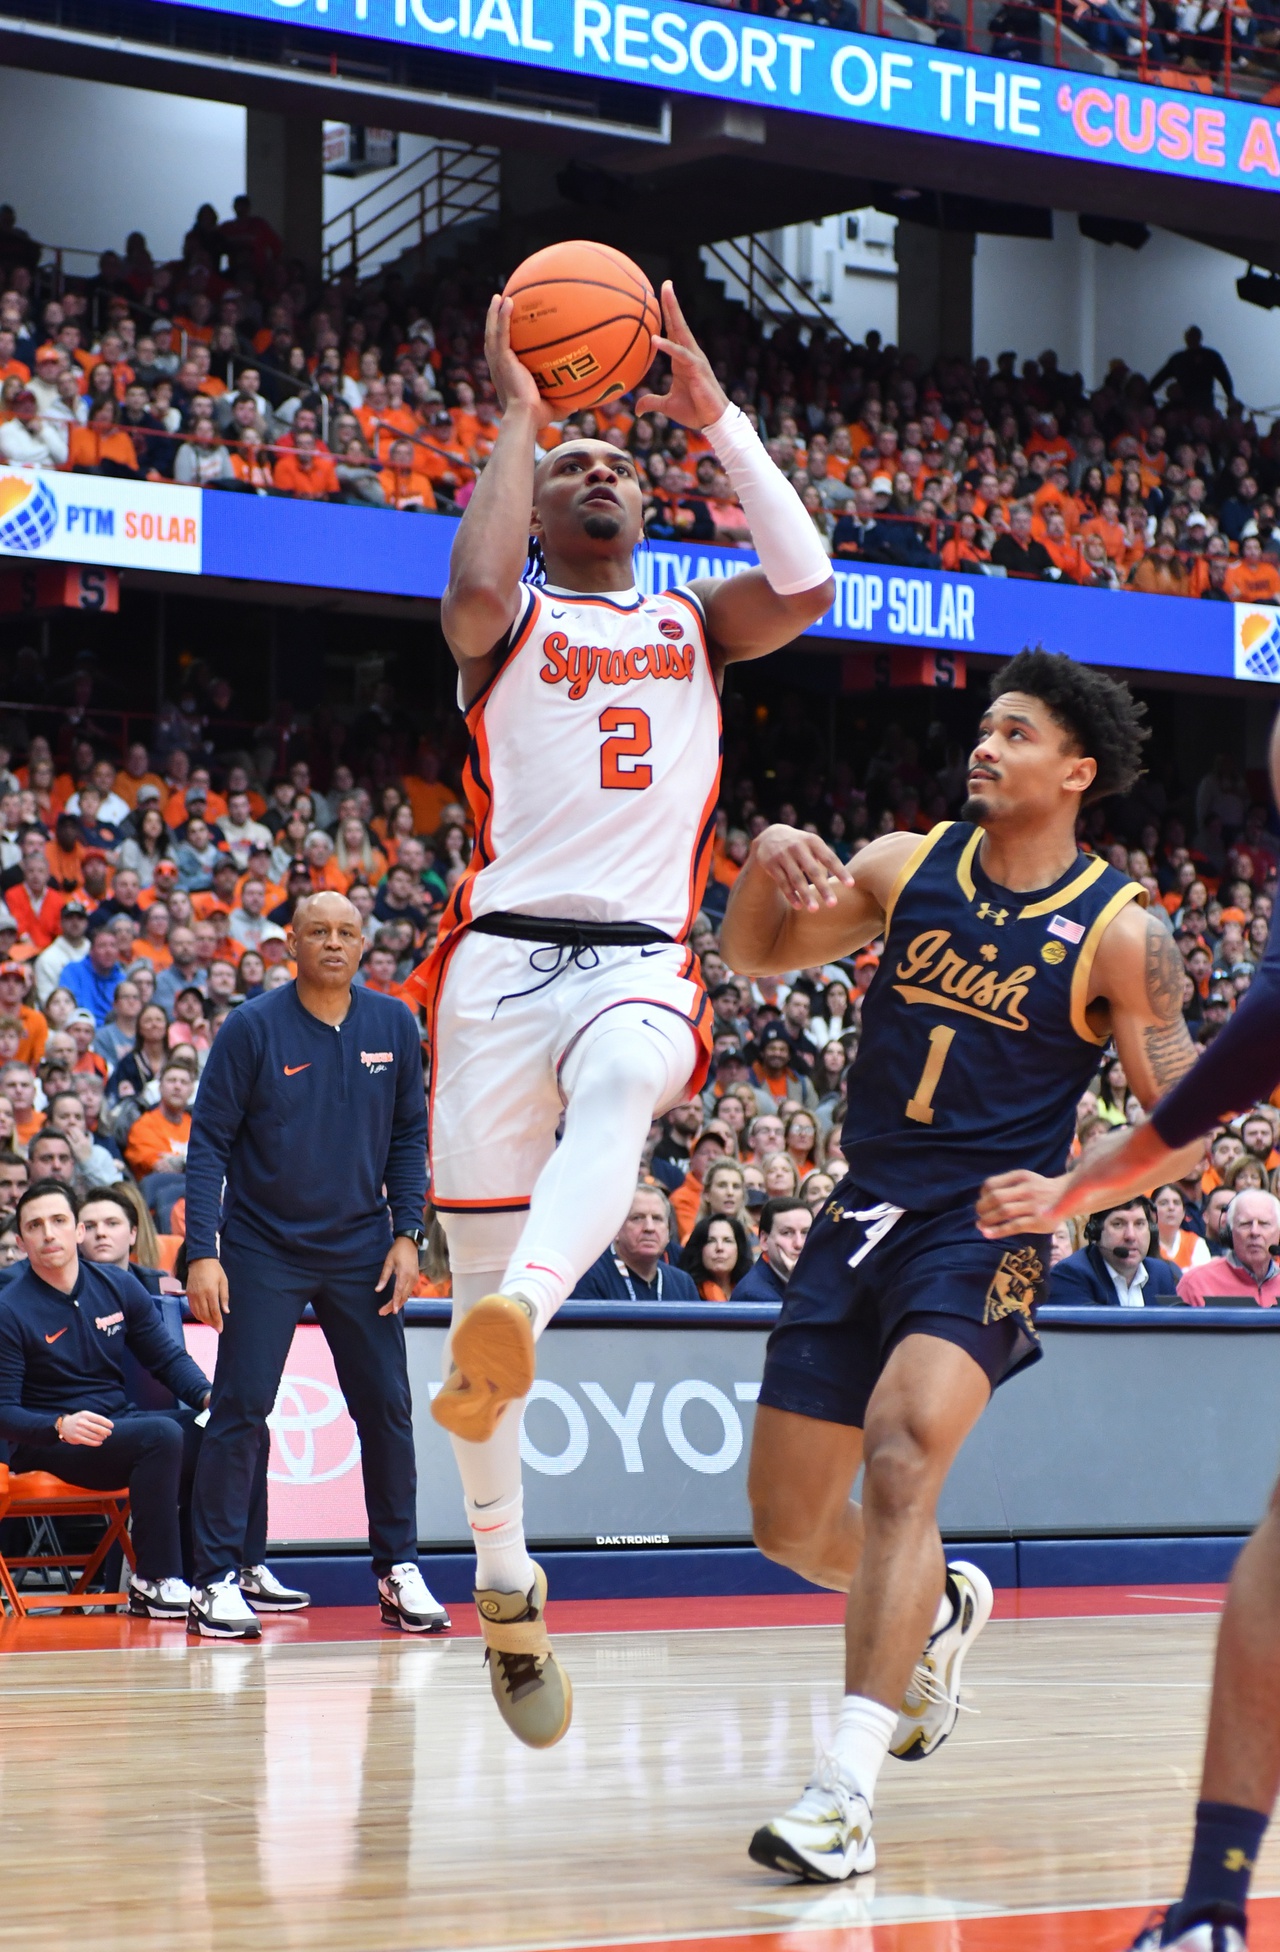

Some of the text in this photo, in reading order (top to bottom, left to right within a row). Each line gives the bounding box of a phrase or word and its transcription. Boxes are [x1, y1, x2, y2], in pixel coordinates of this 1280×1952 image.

[574, 6, 815, 96] RESORT
[830, 45, 913, 110] OF
[929, 61, 1041, 137] THE
[1239, 117, 1280, 177] A
[541, 345, 589, 369] CHAMPIO
[66, 505, 197, 544] PTM SOLAR
[632, 550, 693, 595] NITY
[832, 571, 883, 631] TOP
[887, 577, 975, 641] SOLAR
[539, 631, 696, 700] Syracuse
[598, 706, 653, 790] 2
[892, 929, 1037, 1031] Irish
[905, 1024, 957, 1125] 1
[427, 1379, 763, 1476] OYO
[596, 1535, 670, 1546] DAKTRONICS
